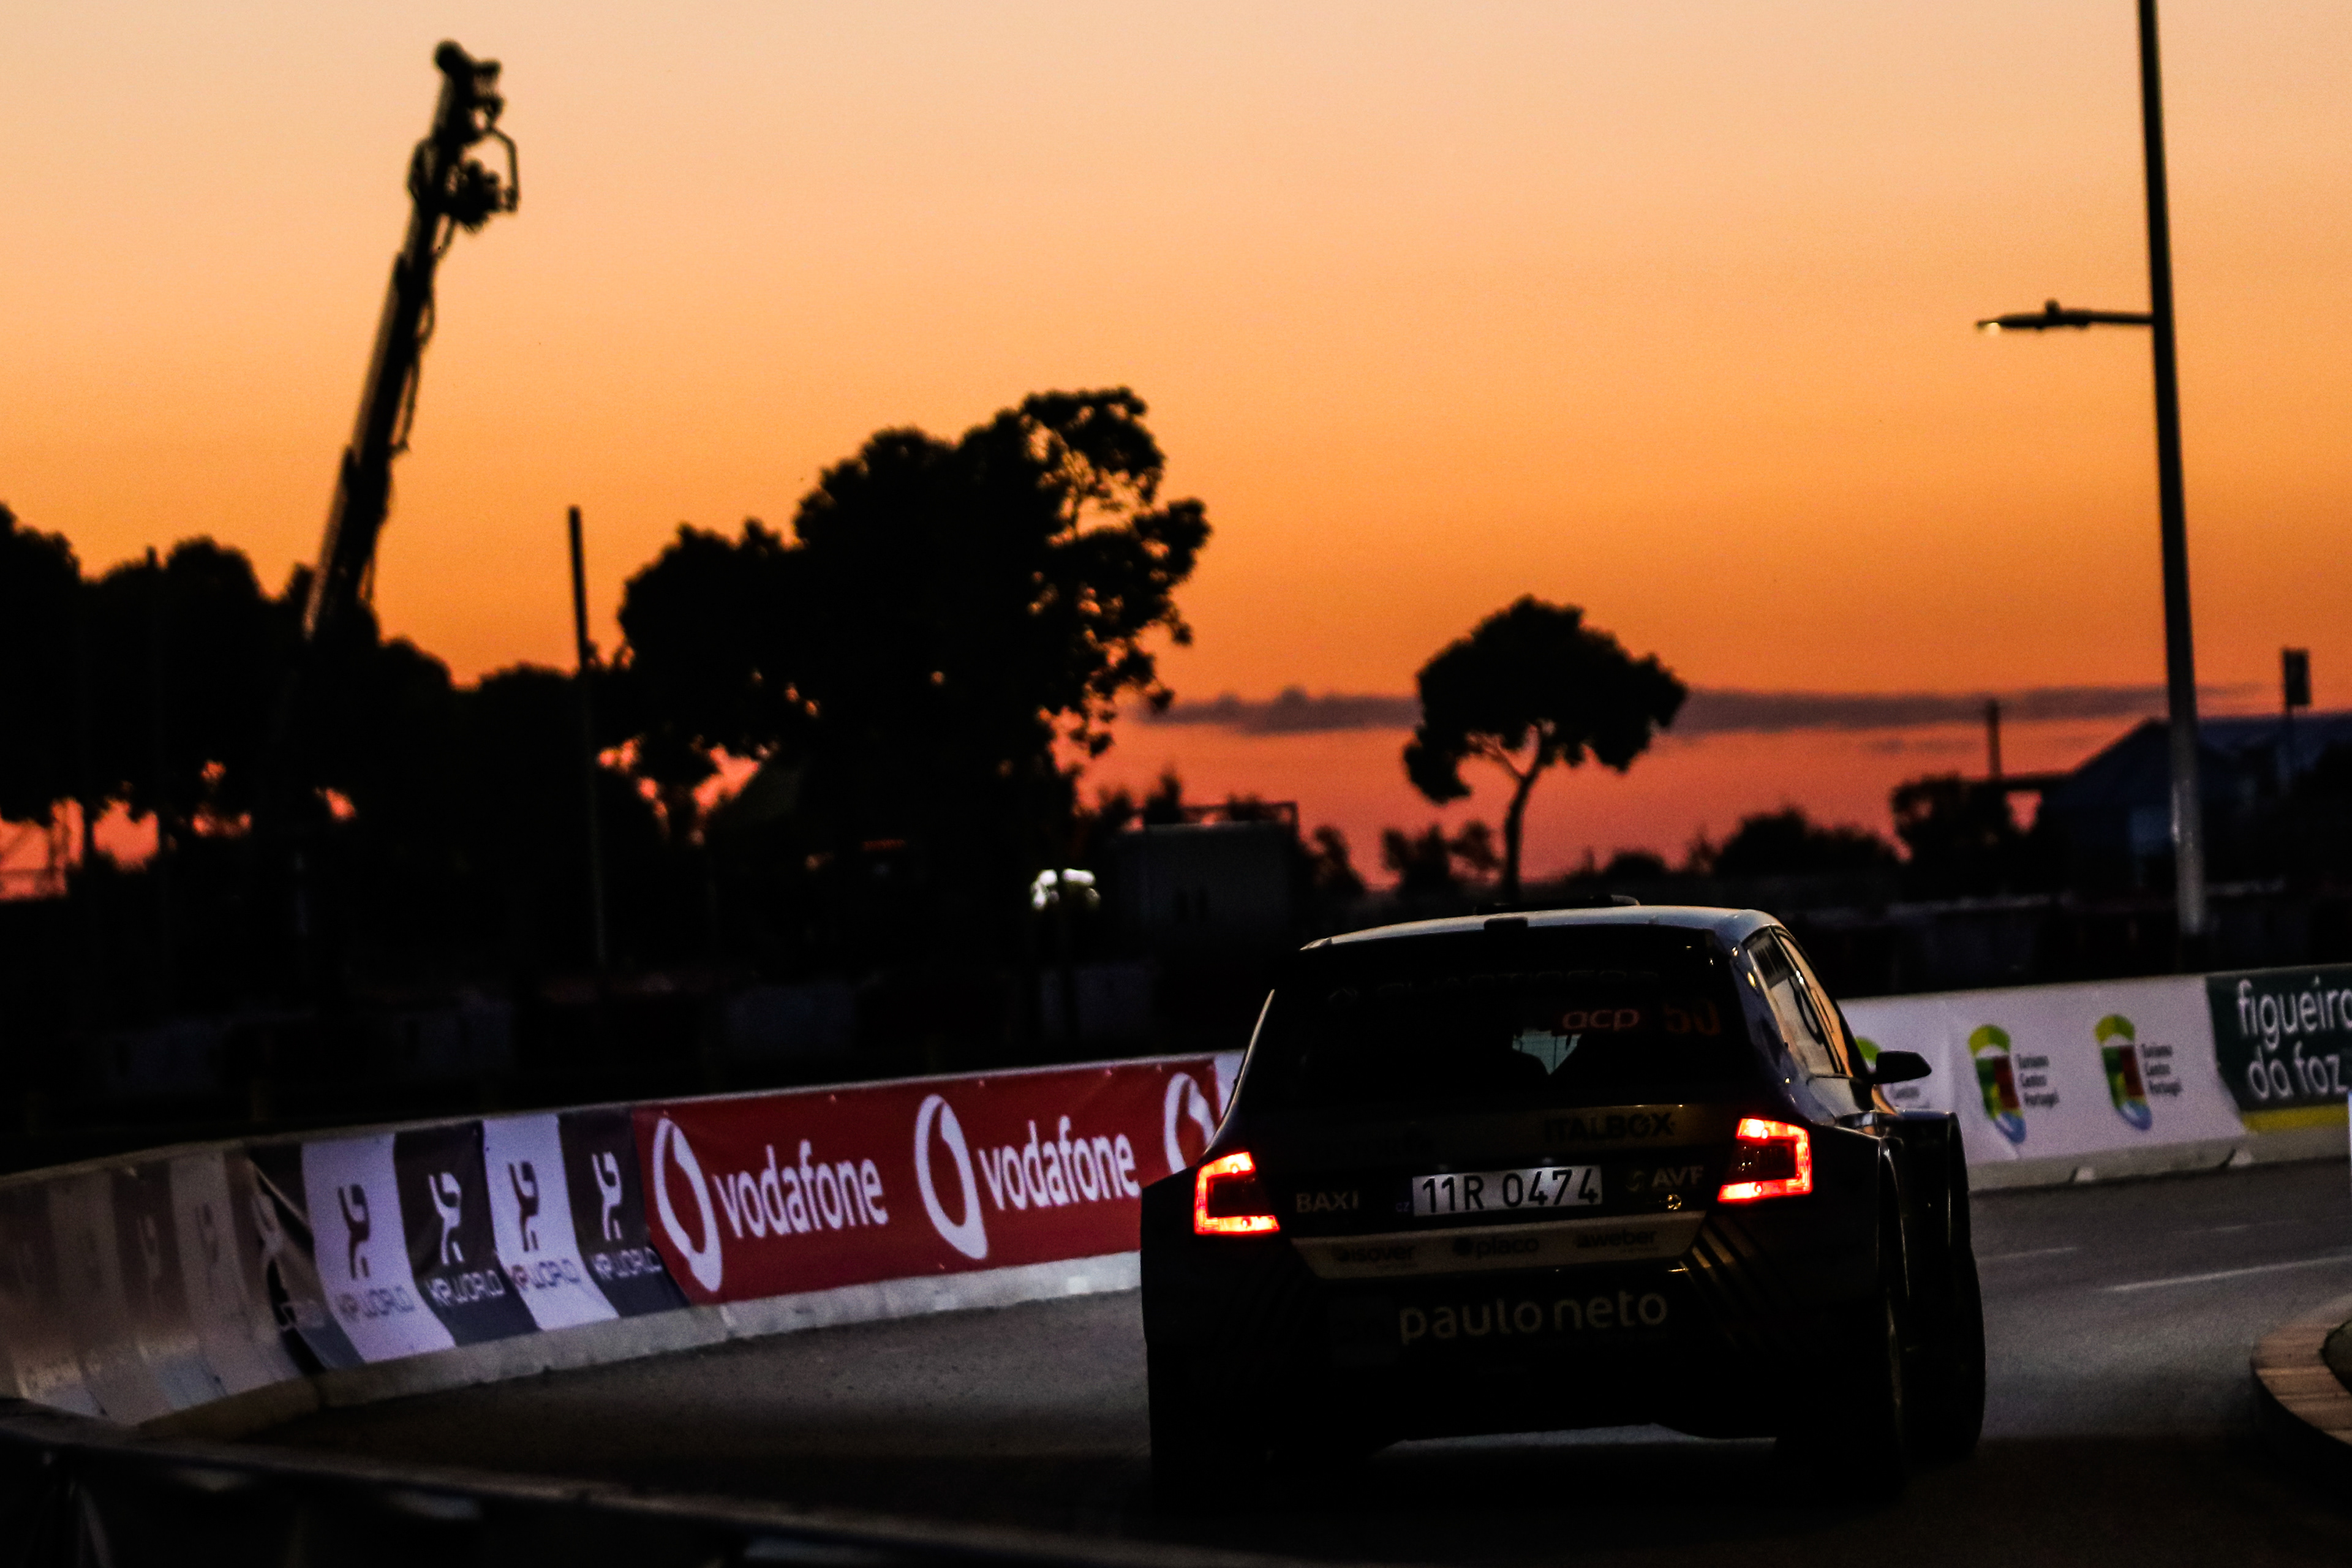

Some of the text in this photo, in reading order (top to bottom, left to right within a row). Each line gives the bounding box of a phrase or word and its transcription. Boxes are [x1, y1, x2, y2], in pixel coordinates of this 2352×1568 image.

[1562, 1008, 1640, 1033] acp
[2247, 1039, 2349, 1099] da foz
[1544, 1112, 1675, 1144] ITALBOX
[979, 1114, 1141, 1212] vodafone
[1652, 1165, 1705, 1188] AVF
[713, 1139, 889, 1240] vodafone
[1295, 1190, 1360, 1213] BAXI
[1422, 1167, 1598, 1214] 11R 0474
[1395, 1200, 1410, 1213] CZ
[1476, 1236, 1539, 1258] placo
[1590, 1228, 1656, 1247] weber
[1349, 1245, 1415, 1262] isover
[1398, 1289, 1668, 1346] paulo neto
